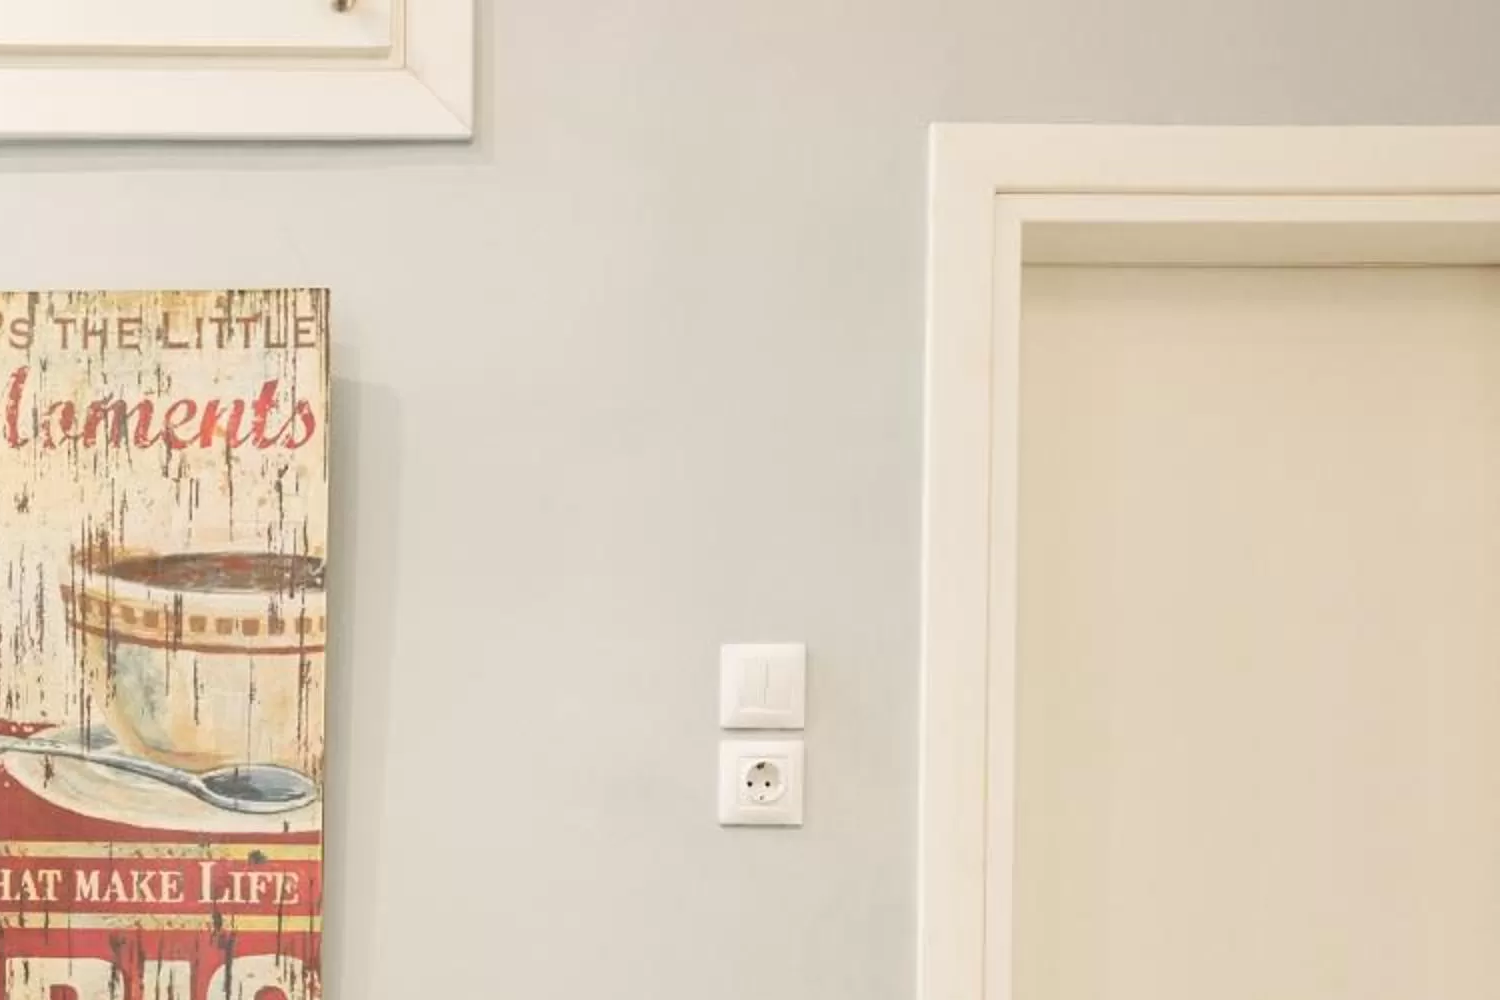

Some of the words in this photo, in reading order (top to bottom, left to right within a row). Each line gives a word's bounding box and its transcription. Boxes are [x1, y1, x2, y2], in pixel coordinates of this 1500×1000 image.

[53, 315, 143, 350] THE
[161, 311, 316, 350] LITTLE
[75, 869, 184, 903] MAKE
